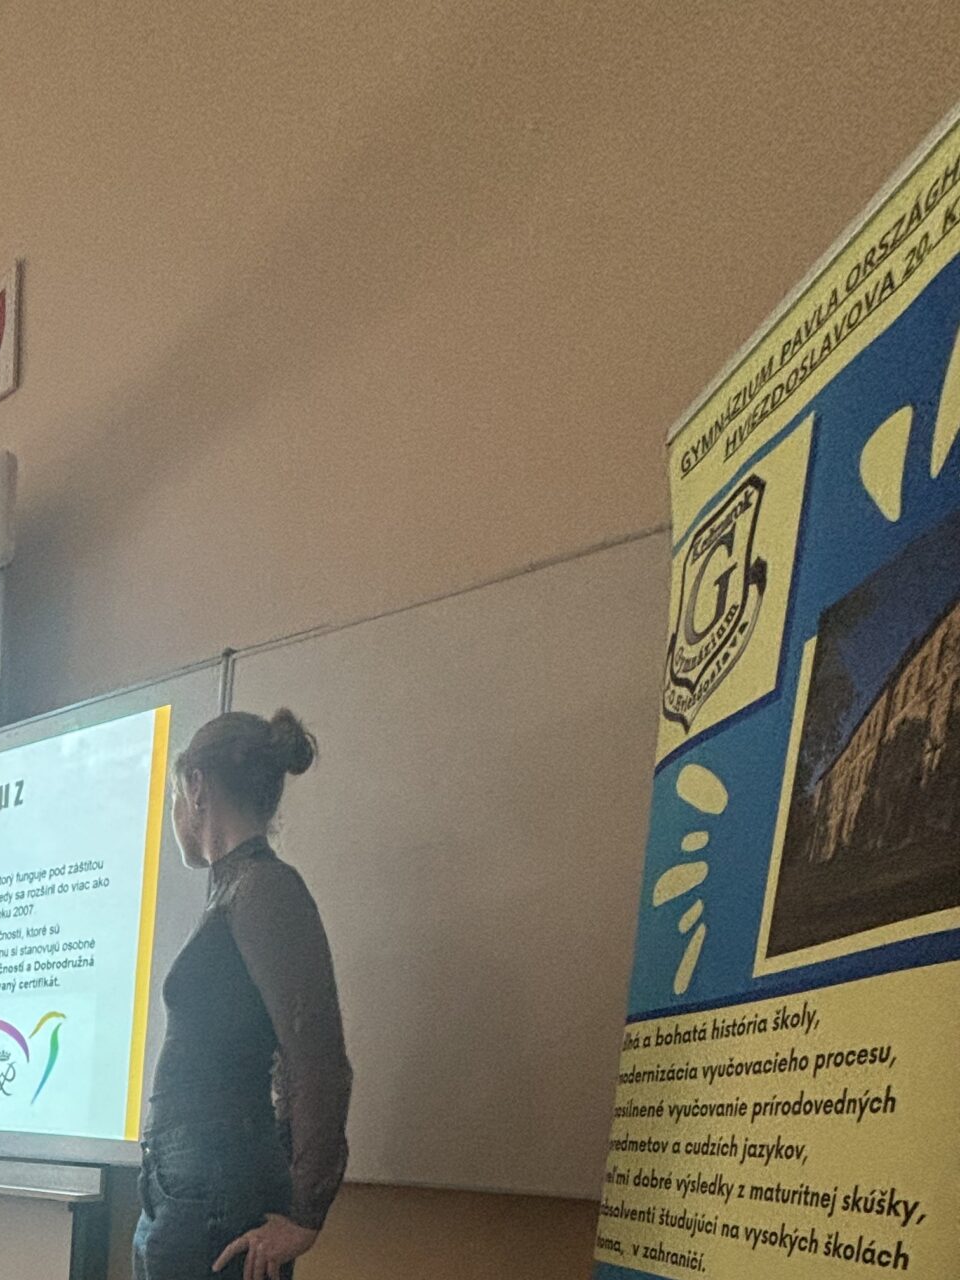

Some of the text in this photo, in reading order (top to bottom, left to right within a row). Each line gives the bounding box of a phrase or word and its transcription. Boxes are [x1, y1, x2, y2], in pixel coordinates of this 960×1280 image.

[779, 287, 838, 366] PAVLA
[724, 270, 895, 457] HVIEZDOSLAVOVA
[683, 522, 738, 645] G
[13, 779, 25, 807] z
[15, 889, 25, 900] sa
[58, 883, 69, 894] do
[71, 880, 90, 892] viac
[92, 877, 110, 889] ako
[16, 869, 47, 884] funguje
[49, 865, 66, 880] pod
[67, 860, 104, 874] záštitou
[26, 926, 47, 937] ktoré
[49, 924, 60, 935] sú
[10, 946, 18, 956] si
[20, 942, 60, 956] stanovujú
[26, 963, 32, 971] a
[34, 955, 95, 971] Dobrodružná
[643, 1036, 651, 1048] a
[655, 1022, 707, 1046] bohatá
[711, 1015, 767, 1040] história
[772, 1001, 820, 1035] školy,
[702, 1047, 809, 1085] vyučovacieho
[812, 1045, 897, 1078] procesu,
[668, 1096, 747, 1124] vyučovanie
[751, 1084, 897, 1124] prírodovedných
[672, 1141, 681, 1153] a
[685, 1133, 738, 1157] cudzích
[740, 1134, 809, 1166] jazykov,
[607, 1165, 927, 1228] eľmi dobré výsledky z maturitnej skúšky,
[632, 1243, 640, 1257] v
[642, 1241, 706, 1273] zahraničí.
[658, 1207, 718, 1239] študujúci
[721, 1222, 740, 1240] na
[744, 1223, 819, 1258] vysokých
[823, 1232, 910, 1271] školách
